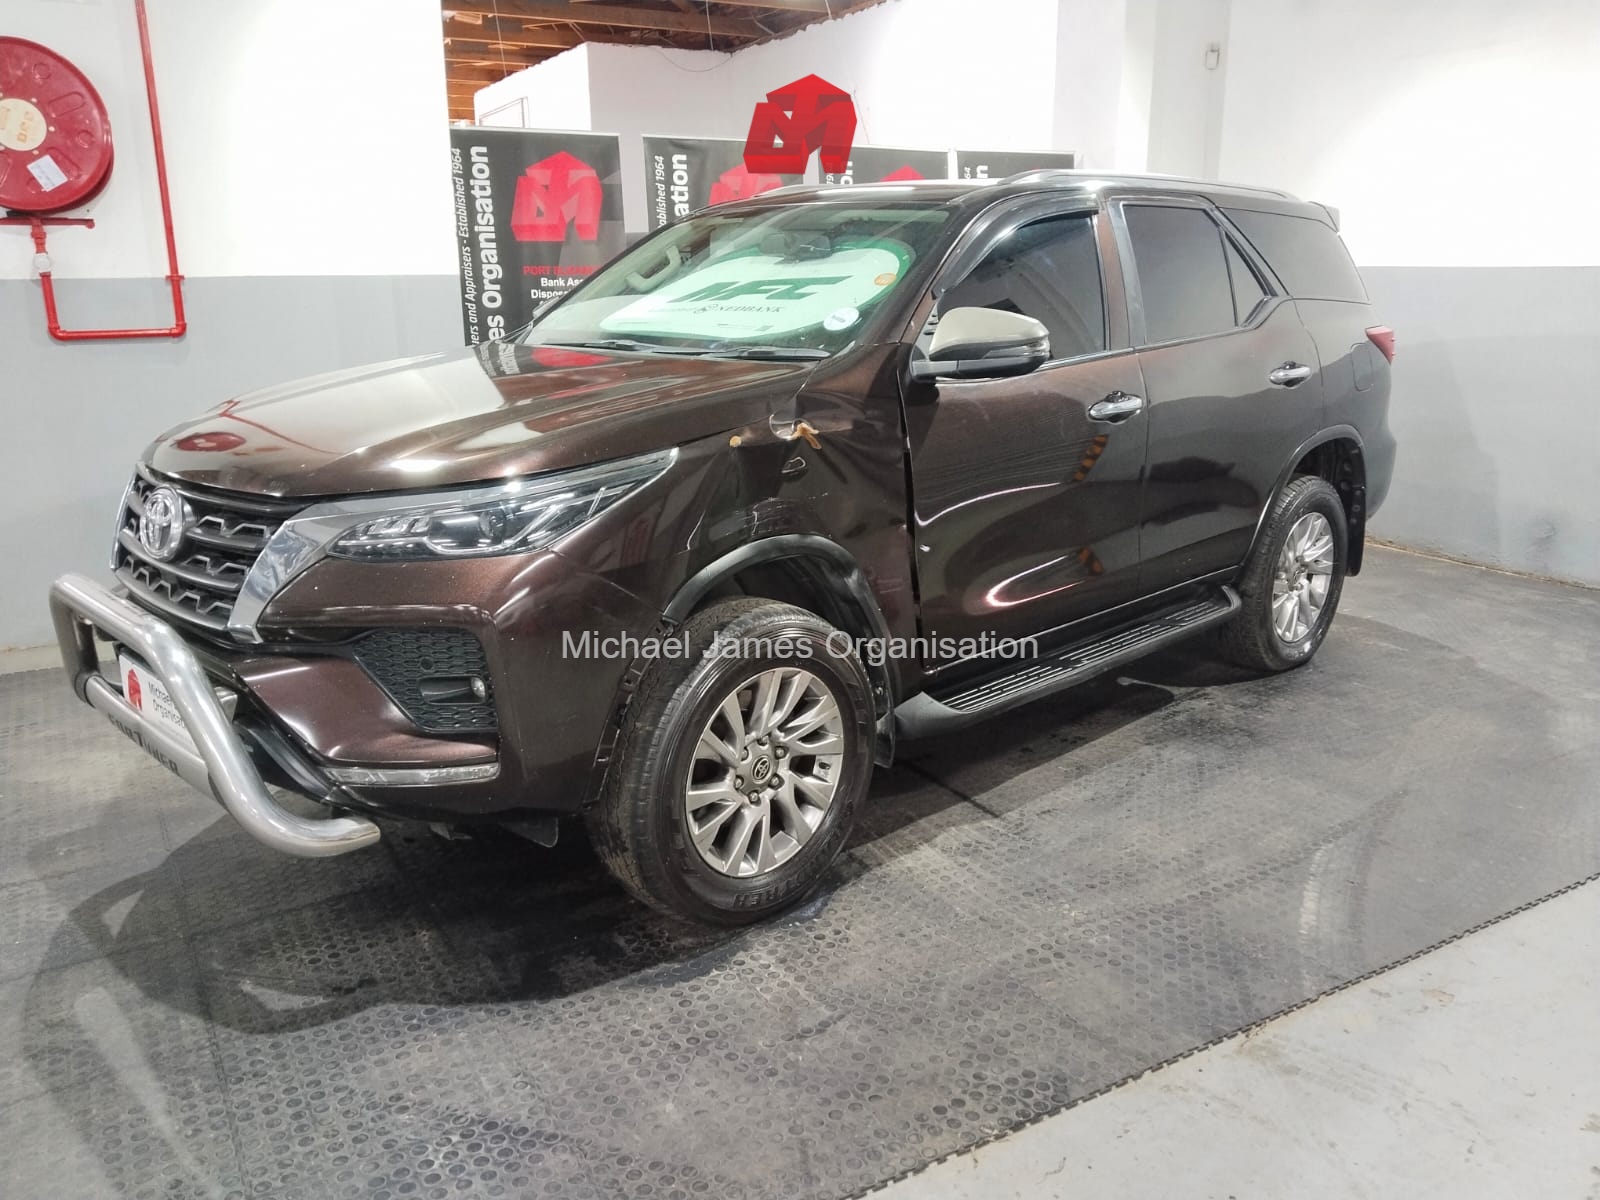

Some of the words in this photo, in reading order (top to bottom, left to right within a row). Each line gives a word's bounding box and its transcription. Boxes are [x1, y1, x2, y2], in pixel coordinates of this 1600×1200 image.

[451, 147, 463, 174] 1964
[654, 155, 664, 180] 1964
[670, 154, 689, 216] ation
[454, 177, 469, 237] Established
[656, 183, 667, 228] ablished
[470, 146, 502, 308] Organisation
[461, 246, 476, 301] Appraisers
[523, 265, 550, 276] PORT
[540, 277, 565, 287] Bank
[465, 302, 478, 323] and
